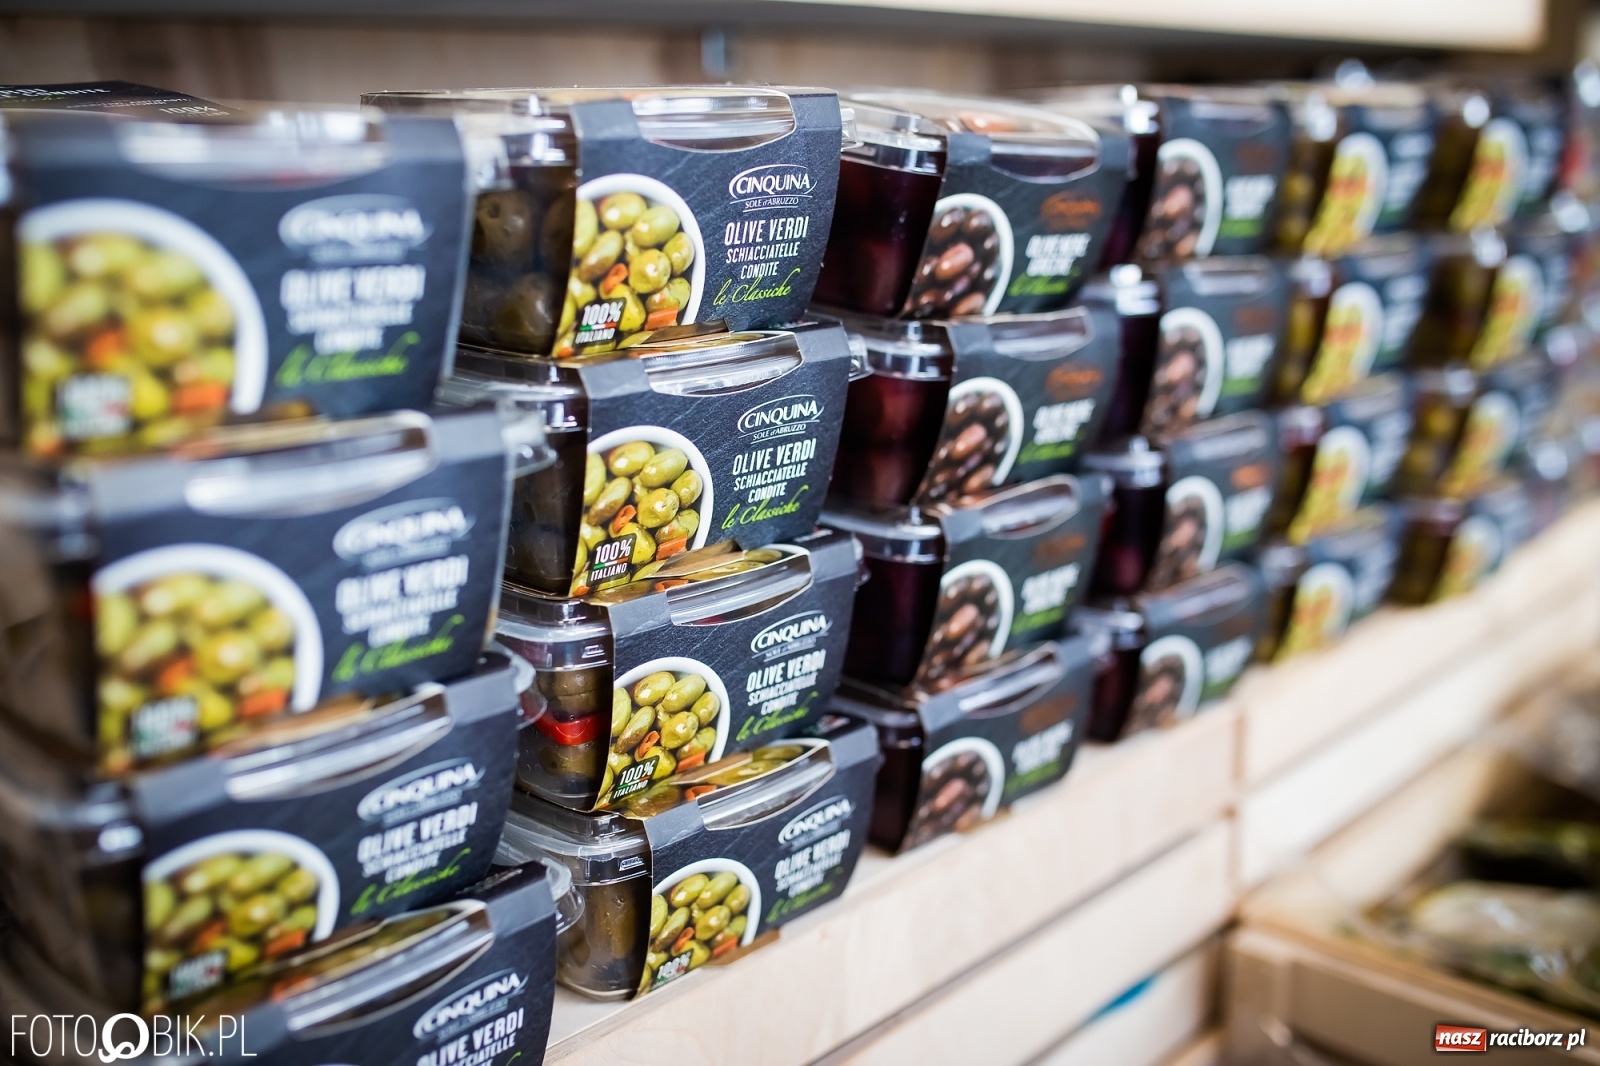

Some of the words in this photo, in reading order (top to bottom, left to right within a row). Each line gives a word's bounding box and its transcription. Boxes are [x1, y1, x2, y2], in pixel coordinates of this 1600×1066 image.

[736, 173, 811, 195] CINQUINA
[745, 199, 762, 209] SOLE
[724, 220, 766, 246] OLIVE
[769, 215, 810, 241] VERDI
[726, 241, 801, 263] SCHIACCIATELLE
[740, 261, 780, 280] CONDITE
[713, 279, 733, 306] le
[732, 268, 801, 303] Classiche
[581, 301, 623, 326] 100%
[744, 400, 819, 429] CINQUINA
[752, 430, 770, 441] SOLE
[732, 447, 774, 476] OLIVE
[776, 438, 817, 466] VERDI
[734, 461, 809, 491] SCHIACCIATELLE
[748, 482, 788, 503] CONDITE
[595, 538, 633, 564] 100%
[590, 562, 628, 581] ITALIANO
[757, 614, 828, 649] CINQUINA
[746, 662, 786, 693] OLIVE
[786, 648, 827, 680] VERDI
[620, 759, 656, 785] 100%
[613, 779, 649, 799] ITALIANO
[421, 971, 522, 1034] CINQUINA
[472, 1006, 525, 1051] VERDI
